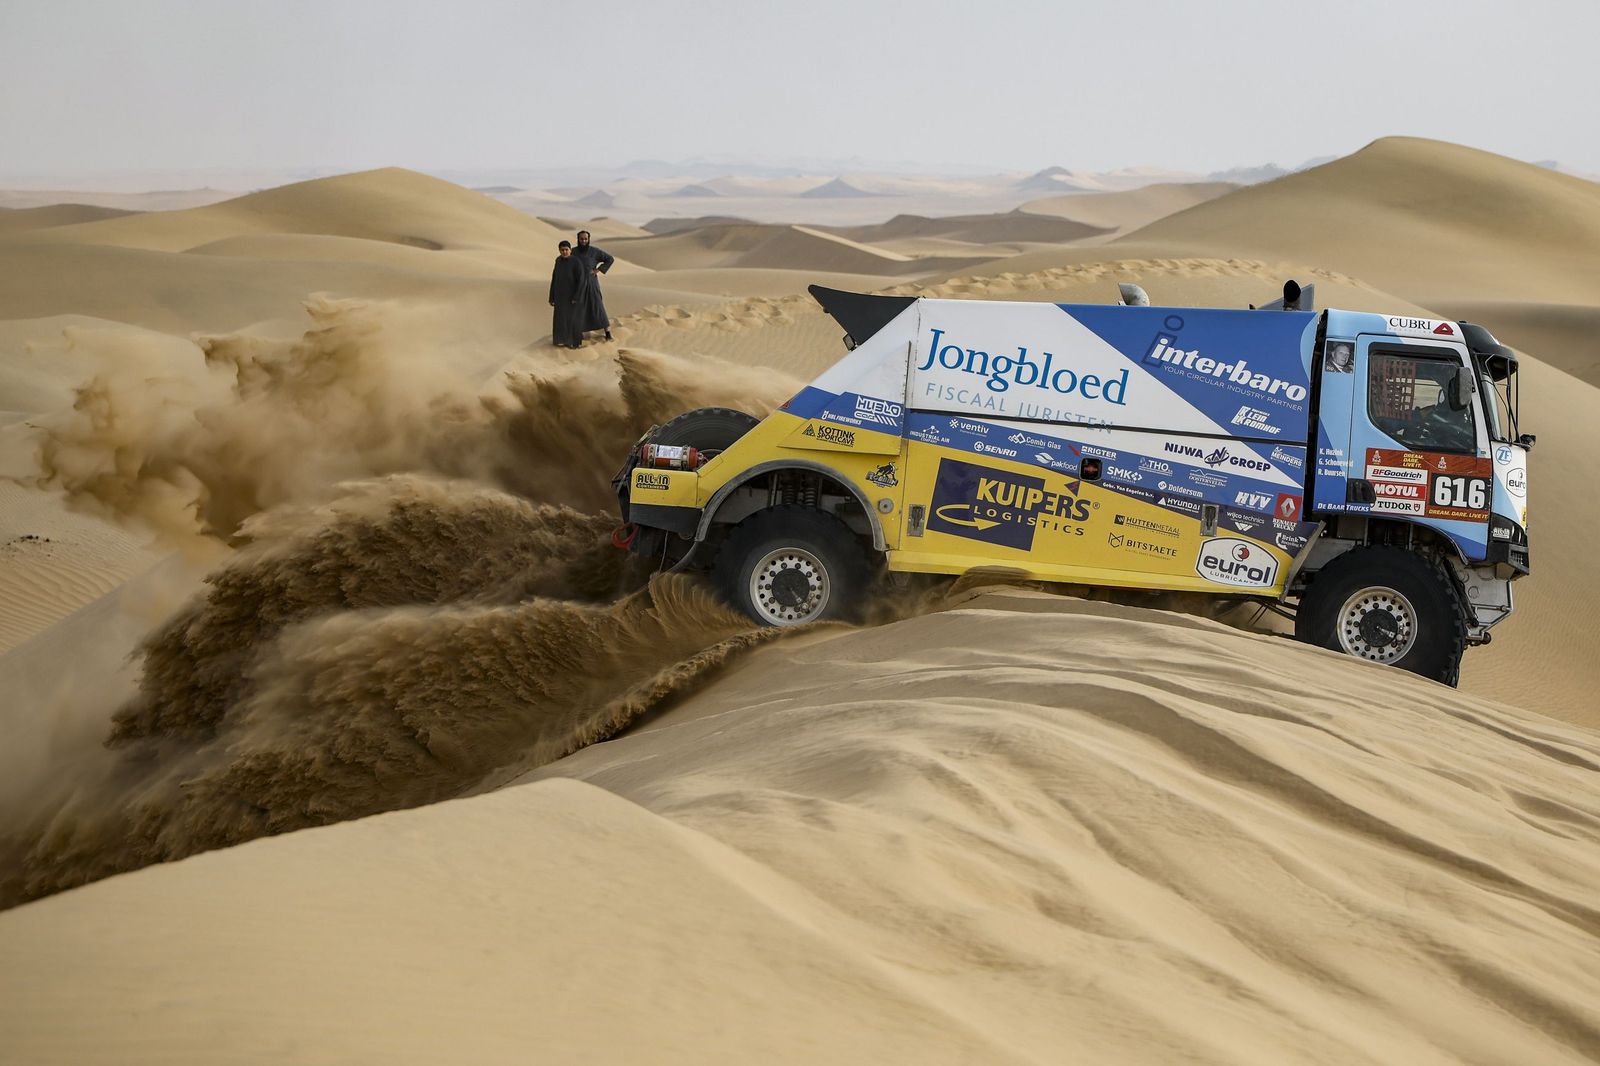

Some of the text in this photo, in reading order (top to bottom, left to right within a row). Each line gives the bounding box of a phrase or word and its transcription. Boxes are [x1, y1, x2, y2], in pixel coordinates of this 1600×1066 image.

[1389, 317, 1431, 330] CUBRI
[917, 328, 1130, 406] Jongbloed
[1150, 337, 1307, 402] interbaro
[1163, 365, 1304, 412] YOUR CIRCULAR INDUSTRY PARTNER
[925, 382, 1006, 413] FISCAAL
[818, 425, 856, 440] KOTTINK
[960, 421, 990, 434] ventiv
[909, 430, 940, 442] INDUSTRIAL
[1025, 436, 1046, 447] Combi
[1047, 440, 1062, 450] Glas
[984, 444, 1018, 457] SENRO
[1087, 447, 1117, 459] RIGTER
[1164, 441, 1203, 459] NIJWA
[1229, 456, 1271, 472] GROEP
[1498, 448, 1511, 463] ZF
[1051, 459, 1078, 471] pakfood
[1148, 460, 1169, 472] THO
[1106, 466, 1132, 480] SMK
[1371, 468, 1422, 479] BFGoodrich
[1167, 483, 1204, 498] Doldersum
[1373, 484, 1418, 497] MOTUL
[1434, 475, 1486, 509] 616
[976, 477, 1091, 522] KUIPERS
[1234, 490, 1272, 510] HVV
[1377, 501, 1412, 511] TUDOR
[973, 505, 1085, 536] LOGISTICS
[1126, 516, 1181, 534] HUTTENMETAAL
[1242, 513, 1265, 524] technics
[1272, 517, 1298, 527] RENAULT
[1273, 522, 1294, 532] TRUCKS
[1282, 534, 1299, 543] Brink
[1126, 539, 1178, 557] BITSTAETE
[1202, 555, 1272, 584] eurol
